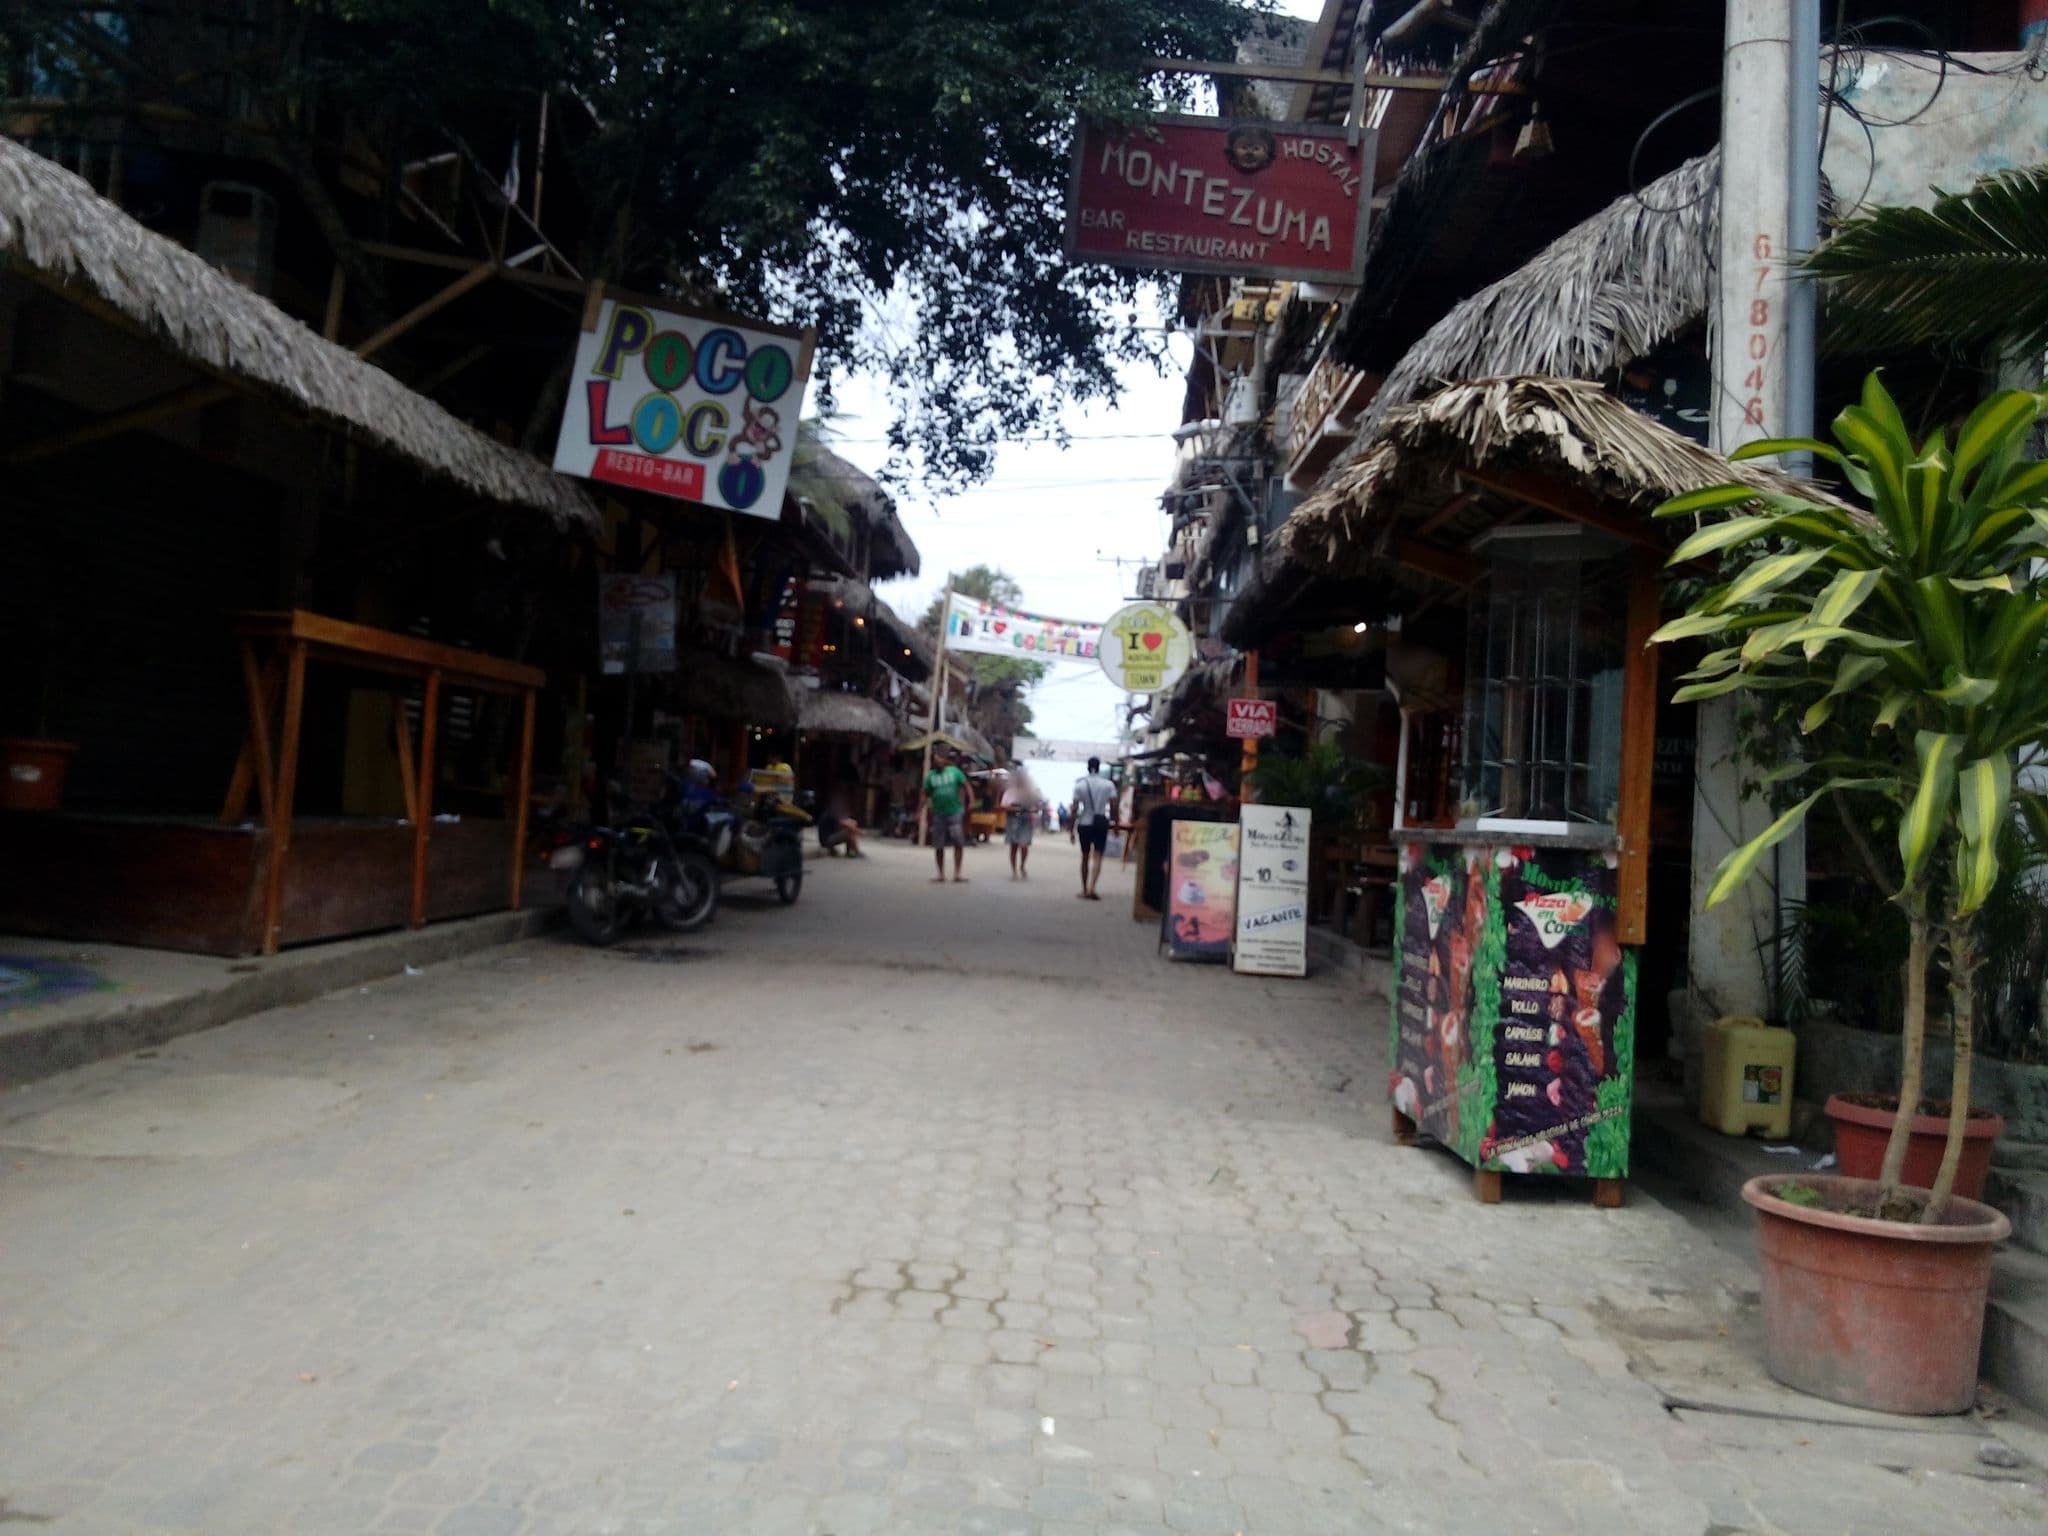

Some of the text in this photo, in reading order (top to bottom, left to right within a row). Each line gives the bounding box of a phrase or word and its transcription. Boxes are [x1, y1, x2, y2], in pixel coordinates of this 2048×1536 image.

[1282, 140, 1362, 197] HOSTAL
[1100, 142, 1332, 253] MONTEZUMA
[1080, 207, 1125, 231] BAR
[1126, 229, 1271, 260] RESTAURANT
[591, 303, 793, 403] POCO
[605, 452, 696, 486] RESTO-BAR
[1127, 632, 1139, 650] I
[1234, 703, 1270, 719] VIA
[1257, 867, 1271, 882] 10
[1524, 892, 1567, 909] Pizza
[1245, 907, 1303, 930] VACANTE
[1511, 1000, 1539, 1015] POLLO
